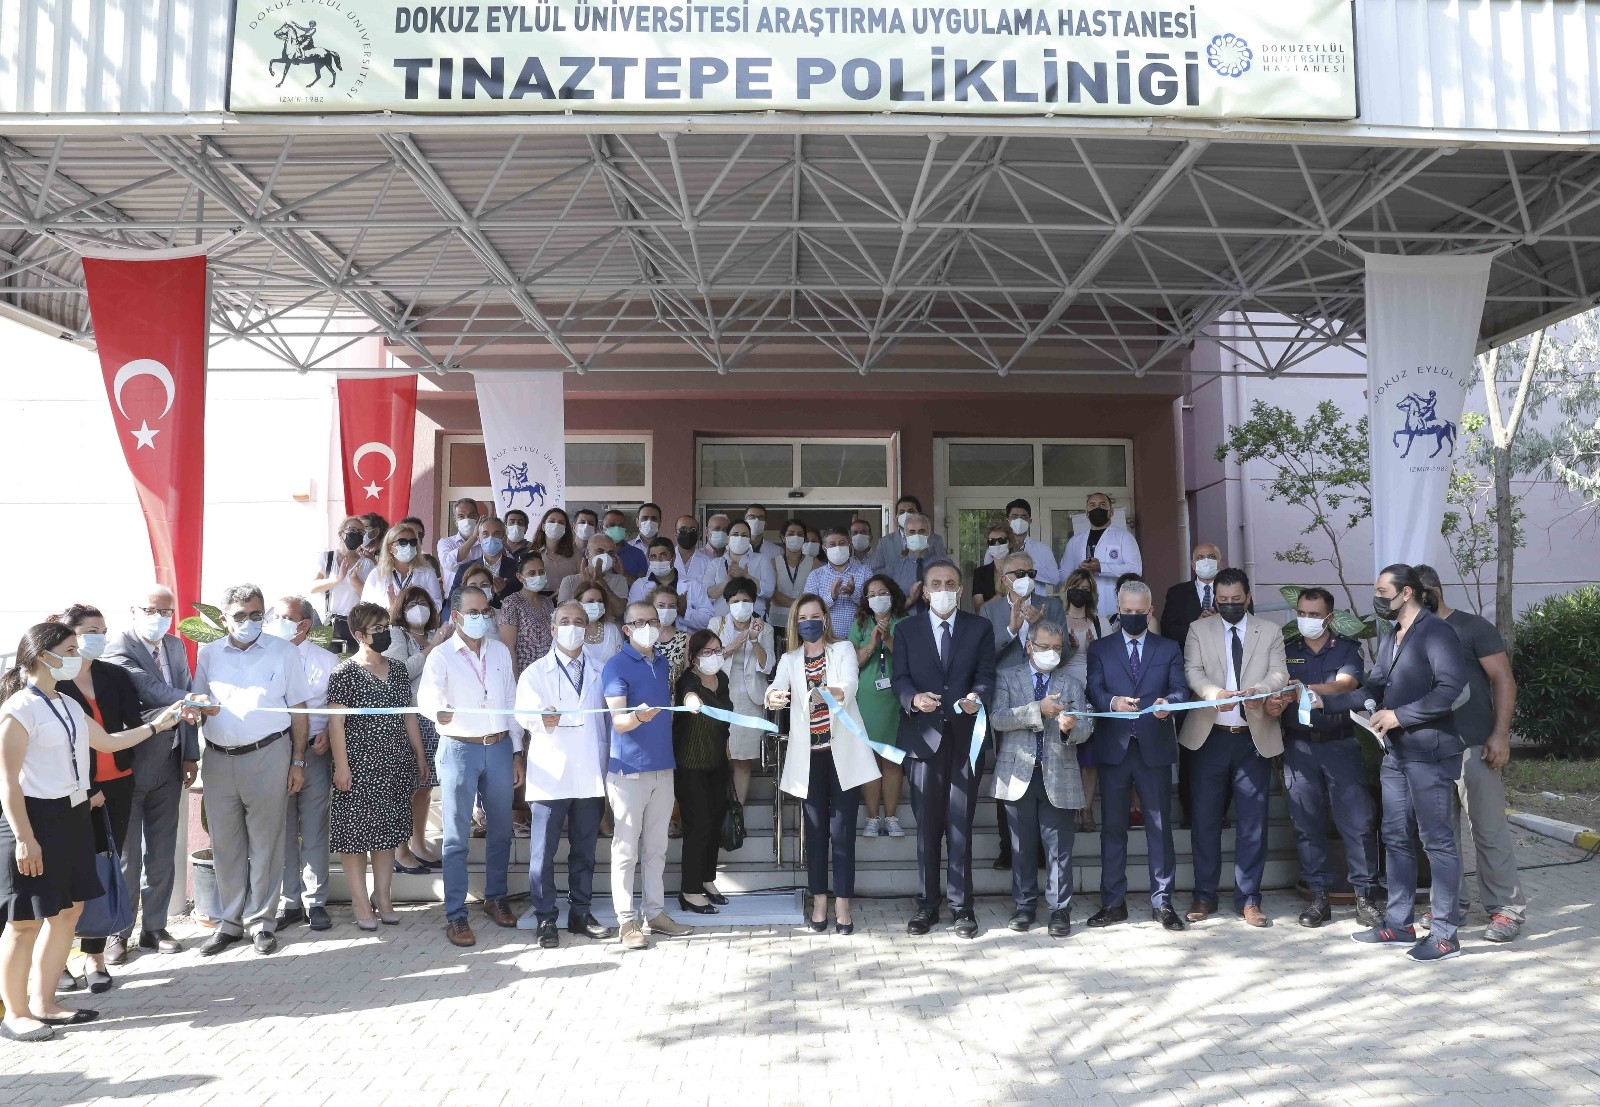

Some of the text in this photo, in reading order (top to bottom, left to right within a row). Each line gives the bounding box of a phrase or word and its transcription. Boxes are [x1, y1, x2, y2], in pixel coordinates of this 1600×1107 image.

[395, 0, 1197, 38] DOKUZ EYLÜL ÜNİVERSİTESİ ARAŞTIRMA UYGULAMA HASTANESİ
[1261, 42, 1345, 53] DOKUZEYLÜL
[393, 46, 1200, 106] TINAZTEPE POLİKLİNİĞİ
[1417, 365, 1454, 380] EYLÜL
